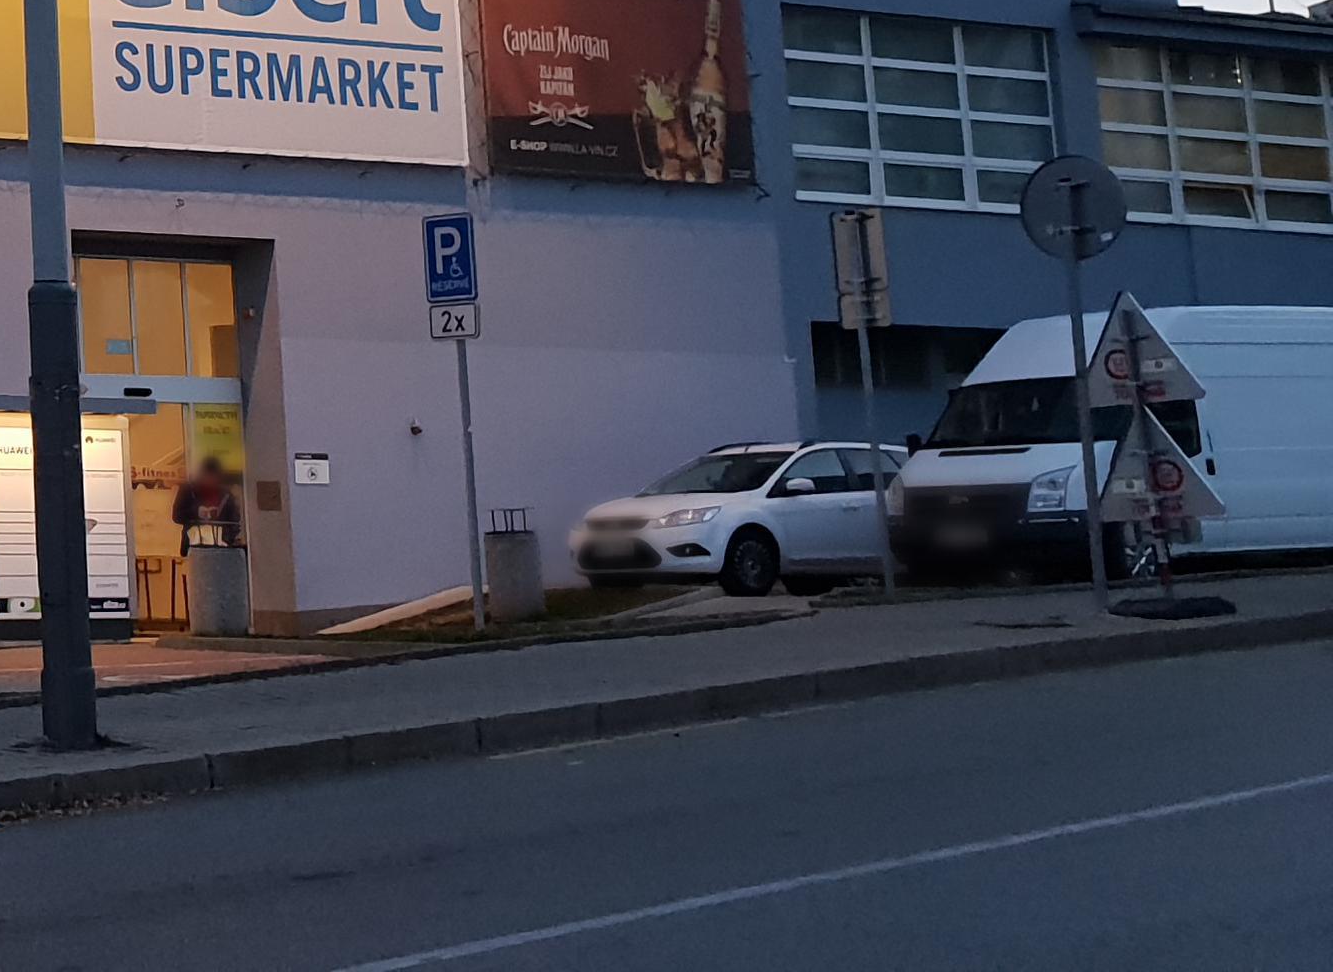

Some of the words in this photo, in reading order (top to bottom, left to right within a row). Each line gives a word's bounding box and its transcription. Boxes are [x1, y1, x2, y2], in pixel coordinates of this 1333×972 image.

[503, 24, 554, 56] Captain
[554, 26, 609, 61] Morgan
[114, 41, 443, 113] SUPERMARKET
[434, 226, 462, 274] P
[441, 310, 465, 333] 2x
